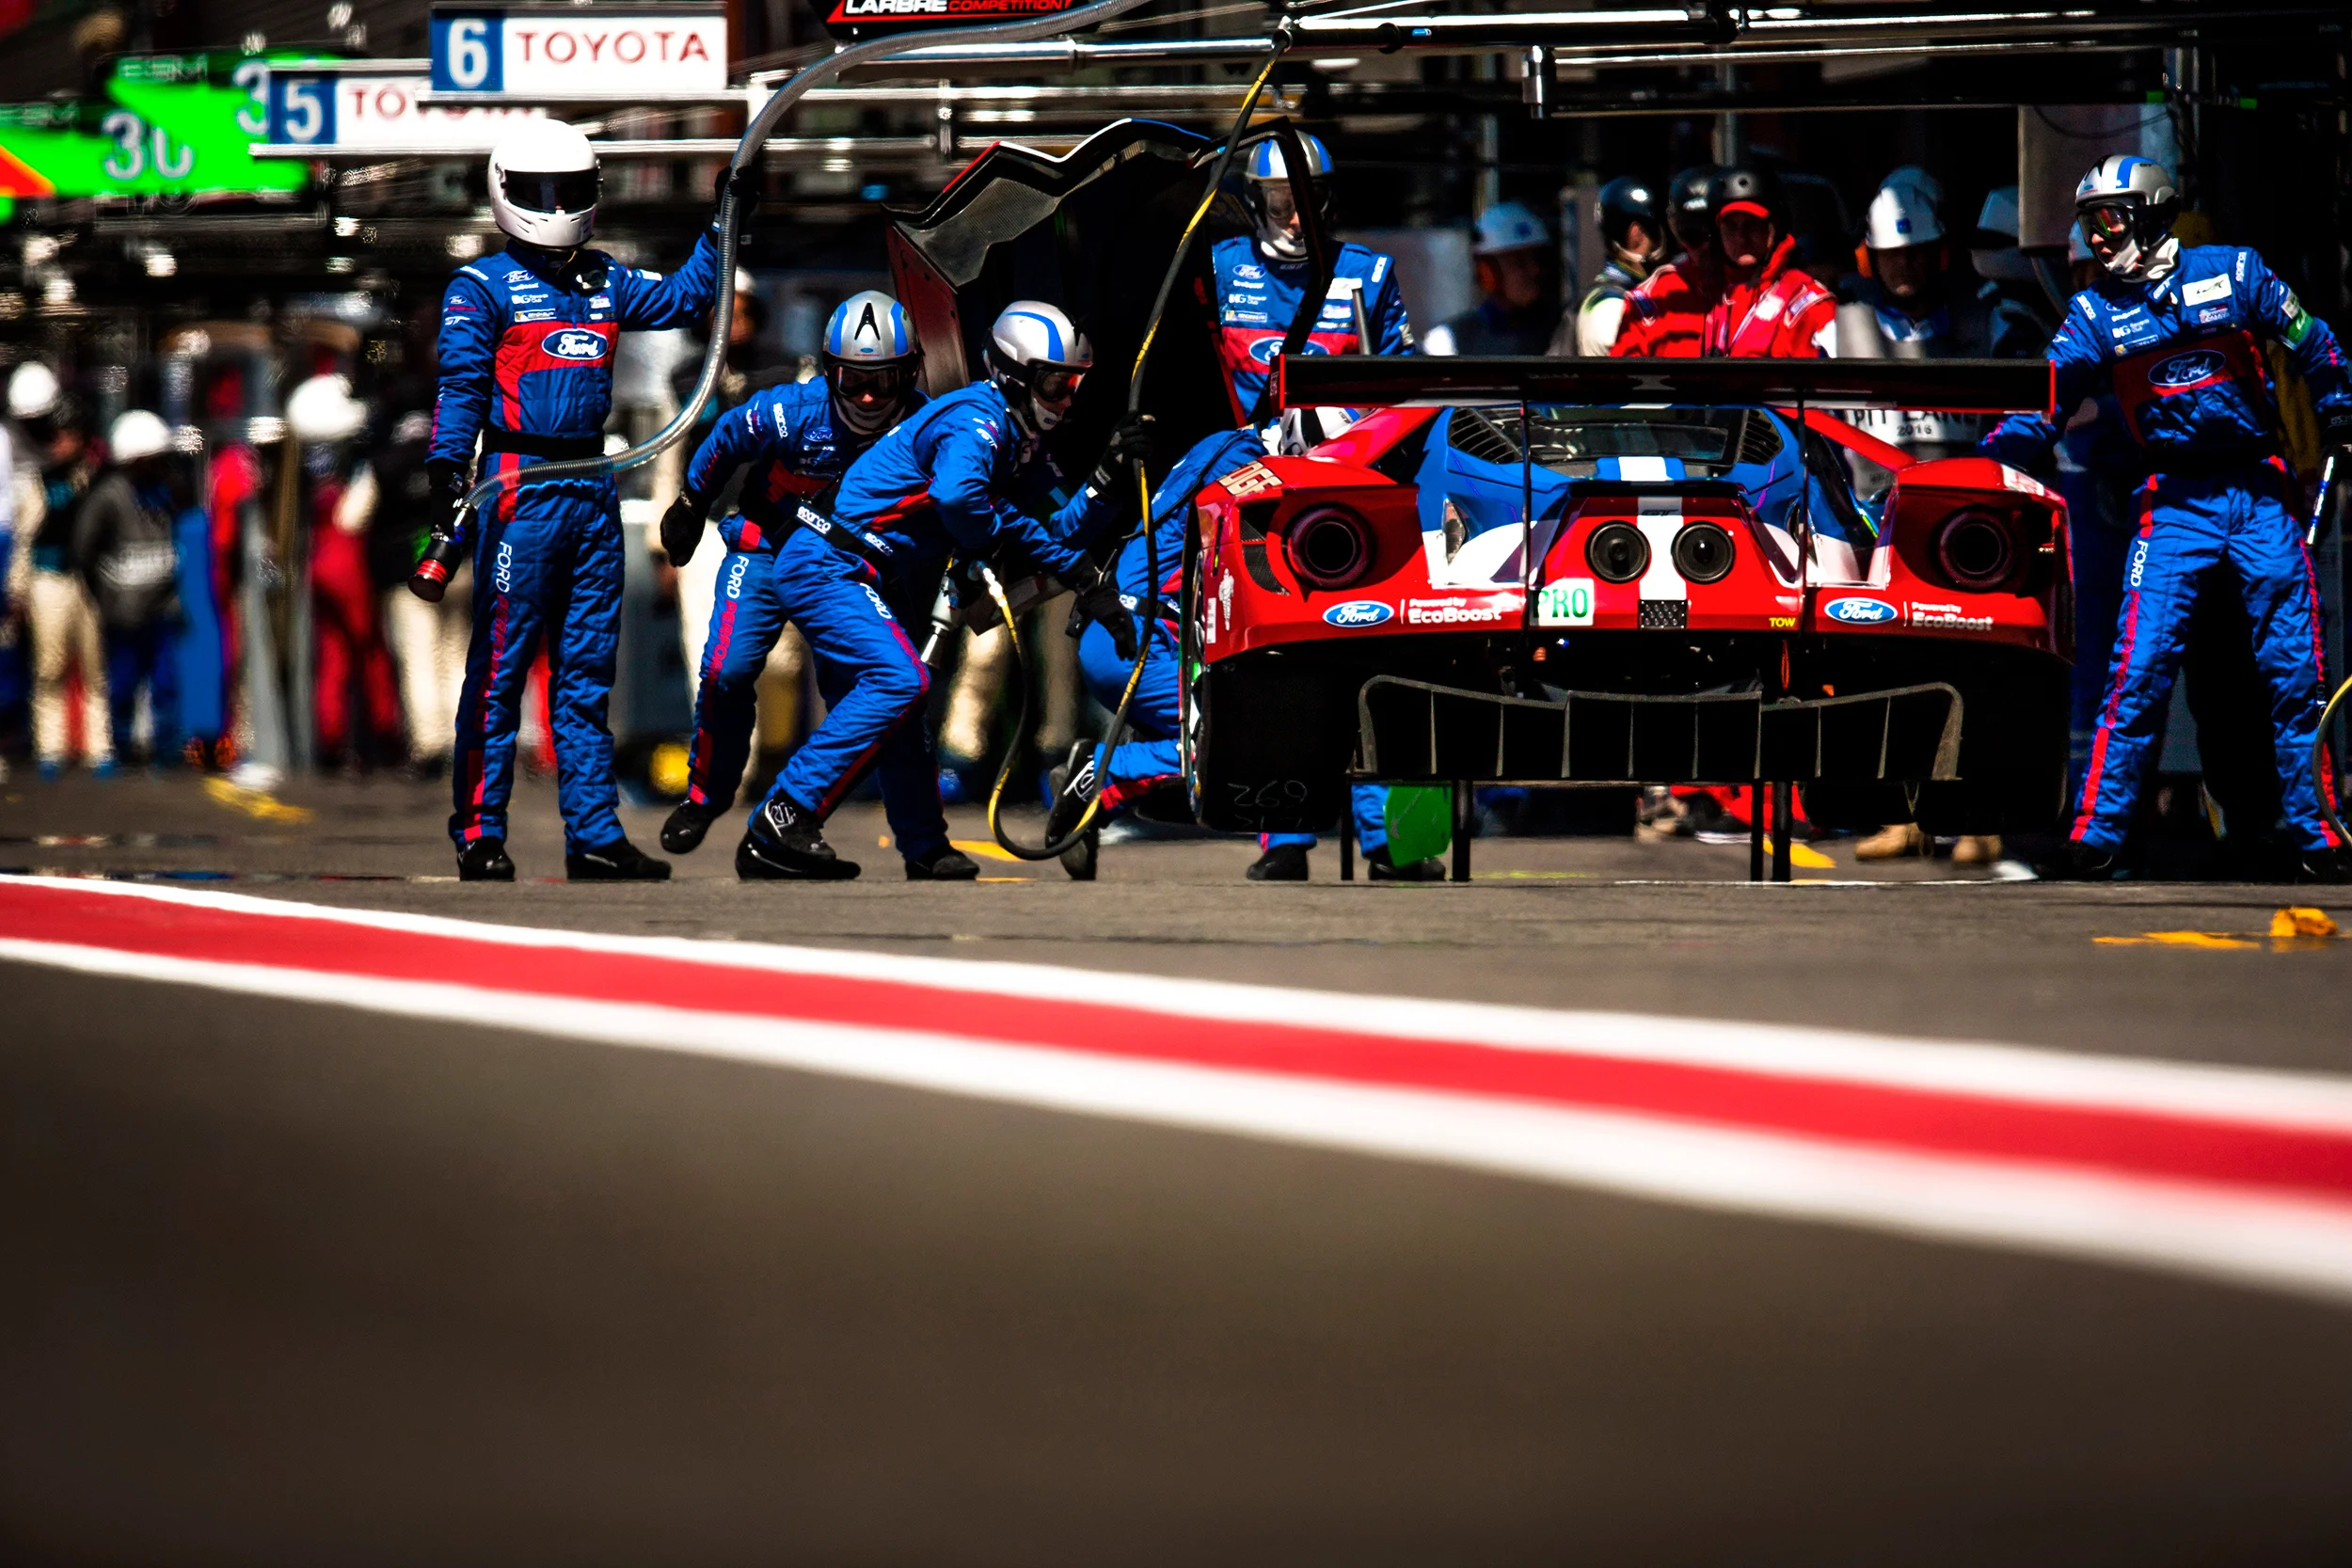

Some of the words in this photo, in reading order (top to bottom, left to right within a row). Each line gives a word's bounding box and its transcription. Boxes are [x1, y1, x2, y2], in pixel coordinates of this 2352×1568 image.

[846, 0, 946, 13] LARBRE
[948, 0, 1062, 11] COMPETITION
[447, 18, 488, 88] 6
[516, 31, 710, 63] TOYOTA
[285, 79, 323, 142] 5
[558, 334, 599, 356] Ford
[2166, 356, 2211, 383] Ford
[1897, 425, 1932, 436] 2016
[797, 505, 831, 533] sparco
[496, 541, 512, 594] FORD
[726, 555, 749, 599] FORD
[2130, 540, 2149, 587] FORD
[860, 582, 892, 619] FORD
[1336, 604, 1377, 624] Ford
[1838, 600, 1883, 620] Ford
[1408, 607, 1502, 624] EcoBoost
[1770, 617, 1795, 627] TOW
[1912, 611, 1994, 631] EcoBoost
